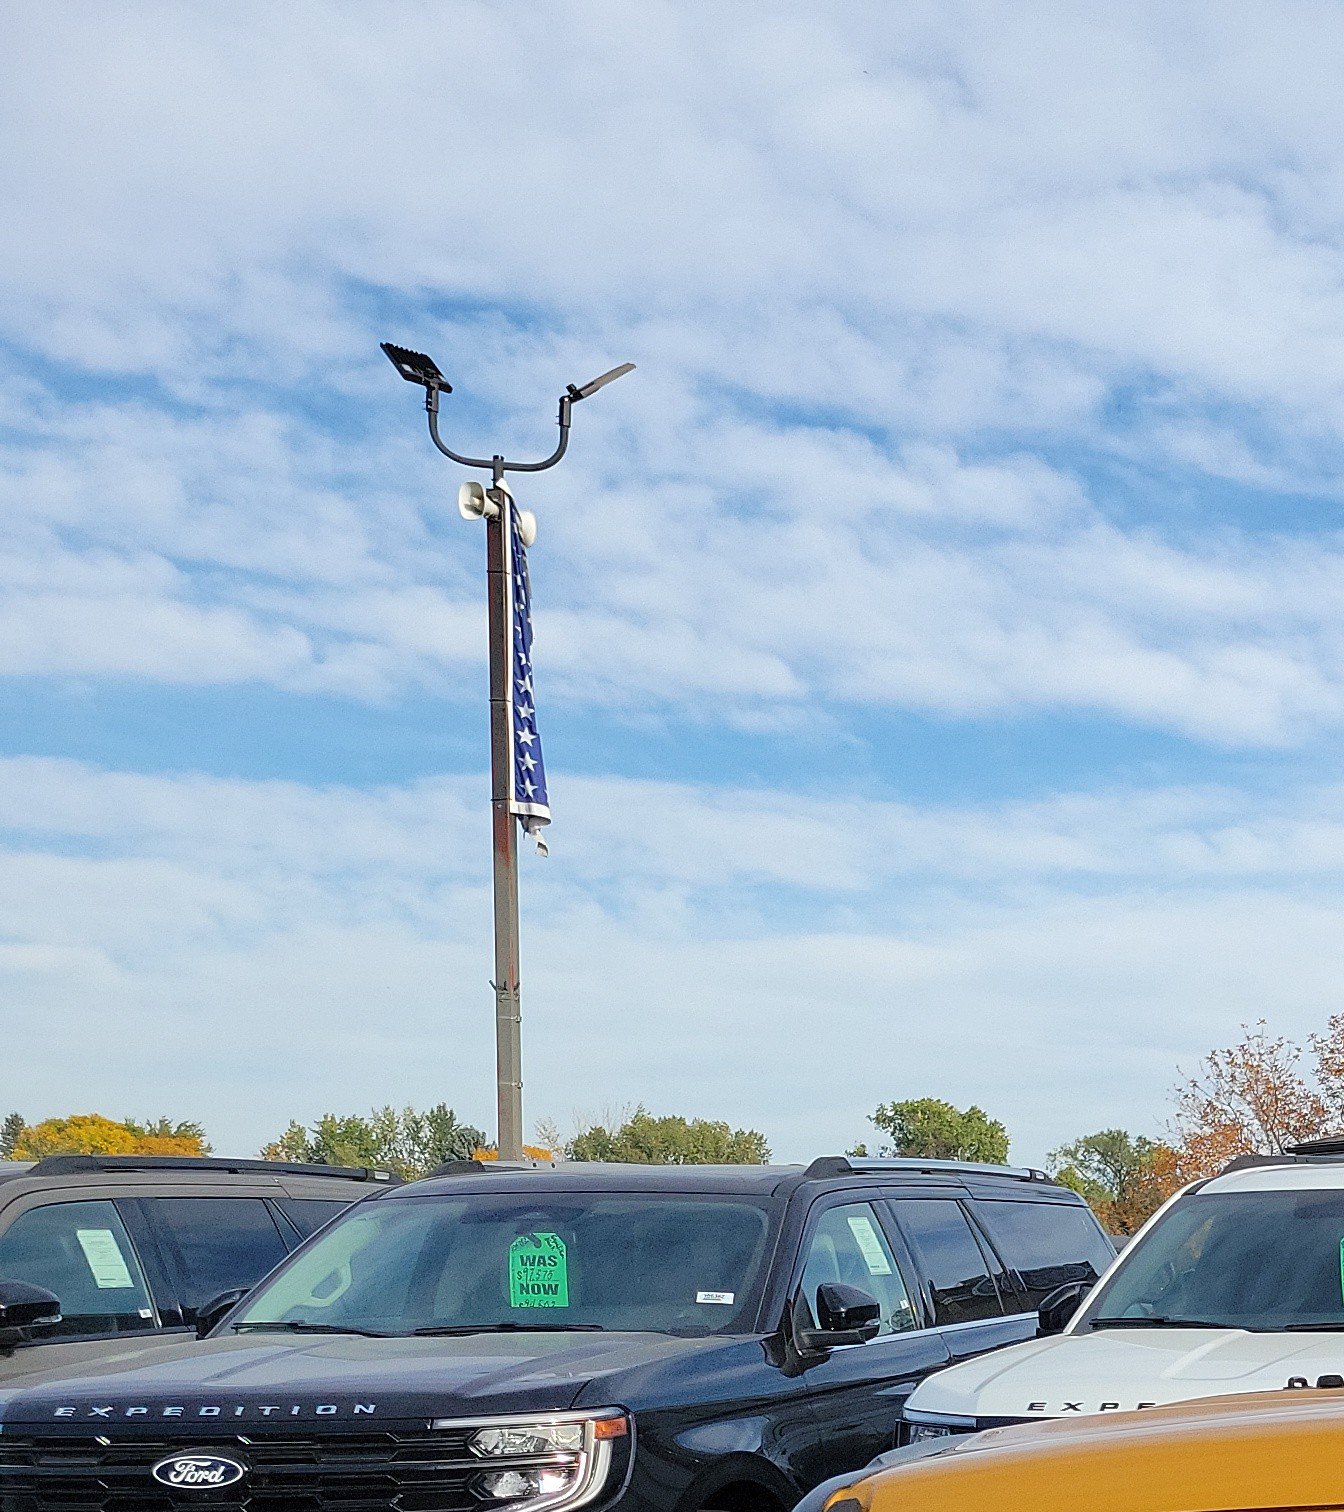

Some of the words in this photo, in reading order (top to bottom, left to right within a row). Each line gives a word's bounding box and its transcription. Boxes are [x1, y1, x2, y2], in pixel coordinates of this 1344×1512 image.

[519, 1254, 557, 1267] WAS
[519, 1283, 559, 1295] NOW
[53, 1404, 377, 1418] EXPEDITION
[171, 1460, 225, 1483] Ford
